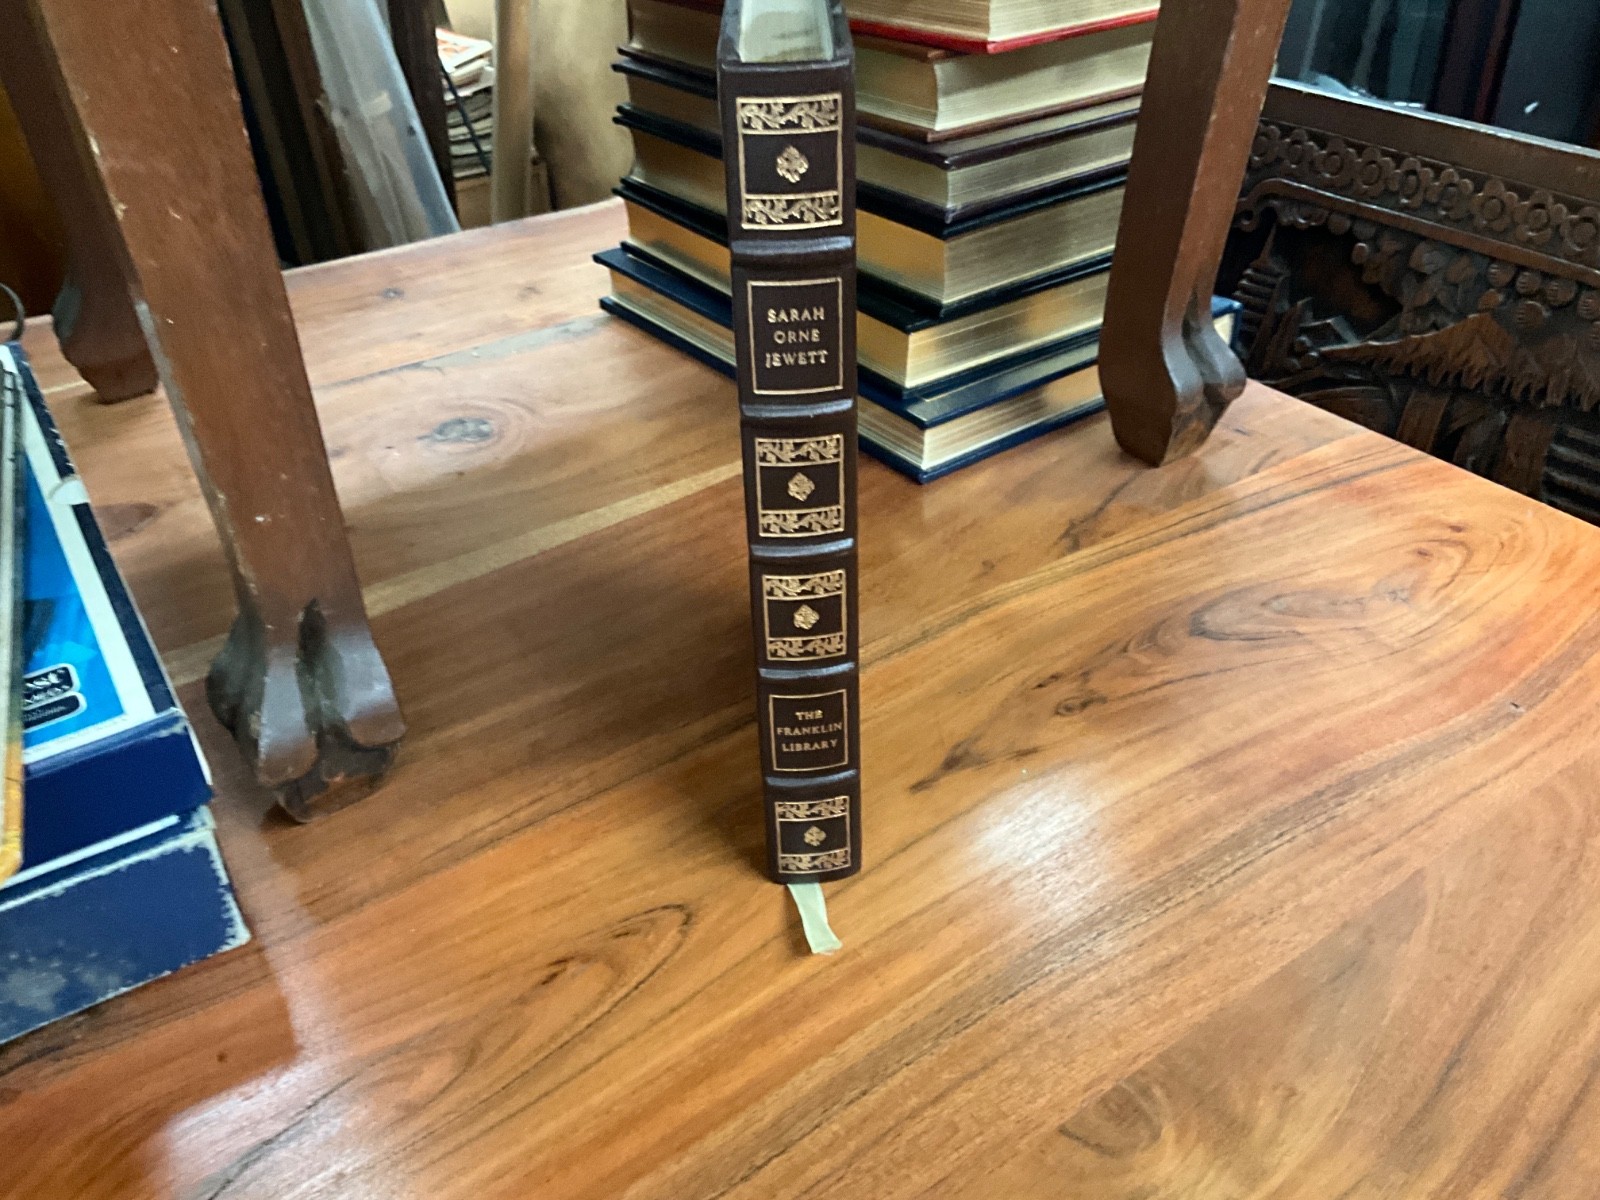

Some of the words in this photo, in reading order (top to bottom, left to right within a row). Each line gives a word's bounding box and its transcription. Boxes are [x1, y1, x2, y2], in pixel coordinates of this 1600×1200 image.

[767, 306, 825, 323] SARAH
[773, 328, 820, 344] ORNE
[765, 349, 828, 368] JEWETT
[795, 709, 823, 720] THE
[776, 722, 842, 736] FRANKLIN
[781, 738, 838, 752] LIBRARY
